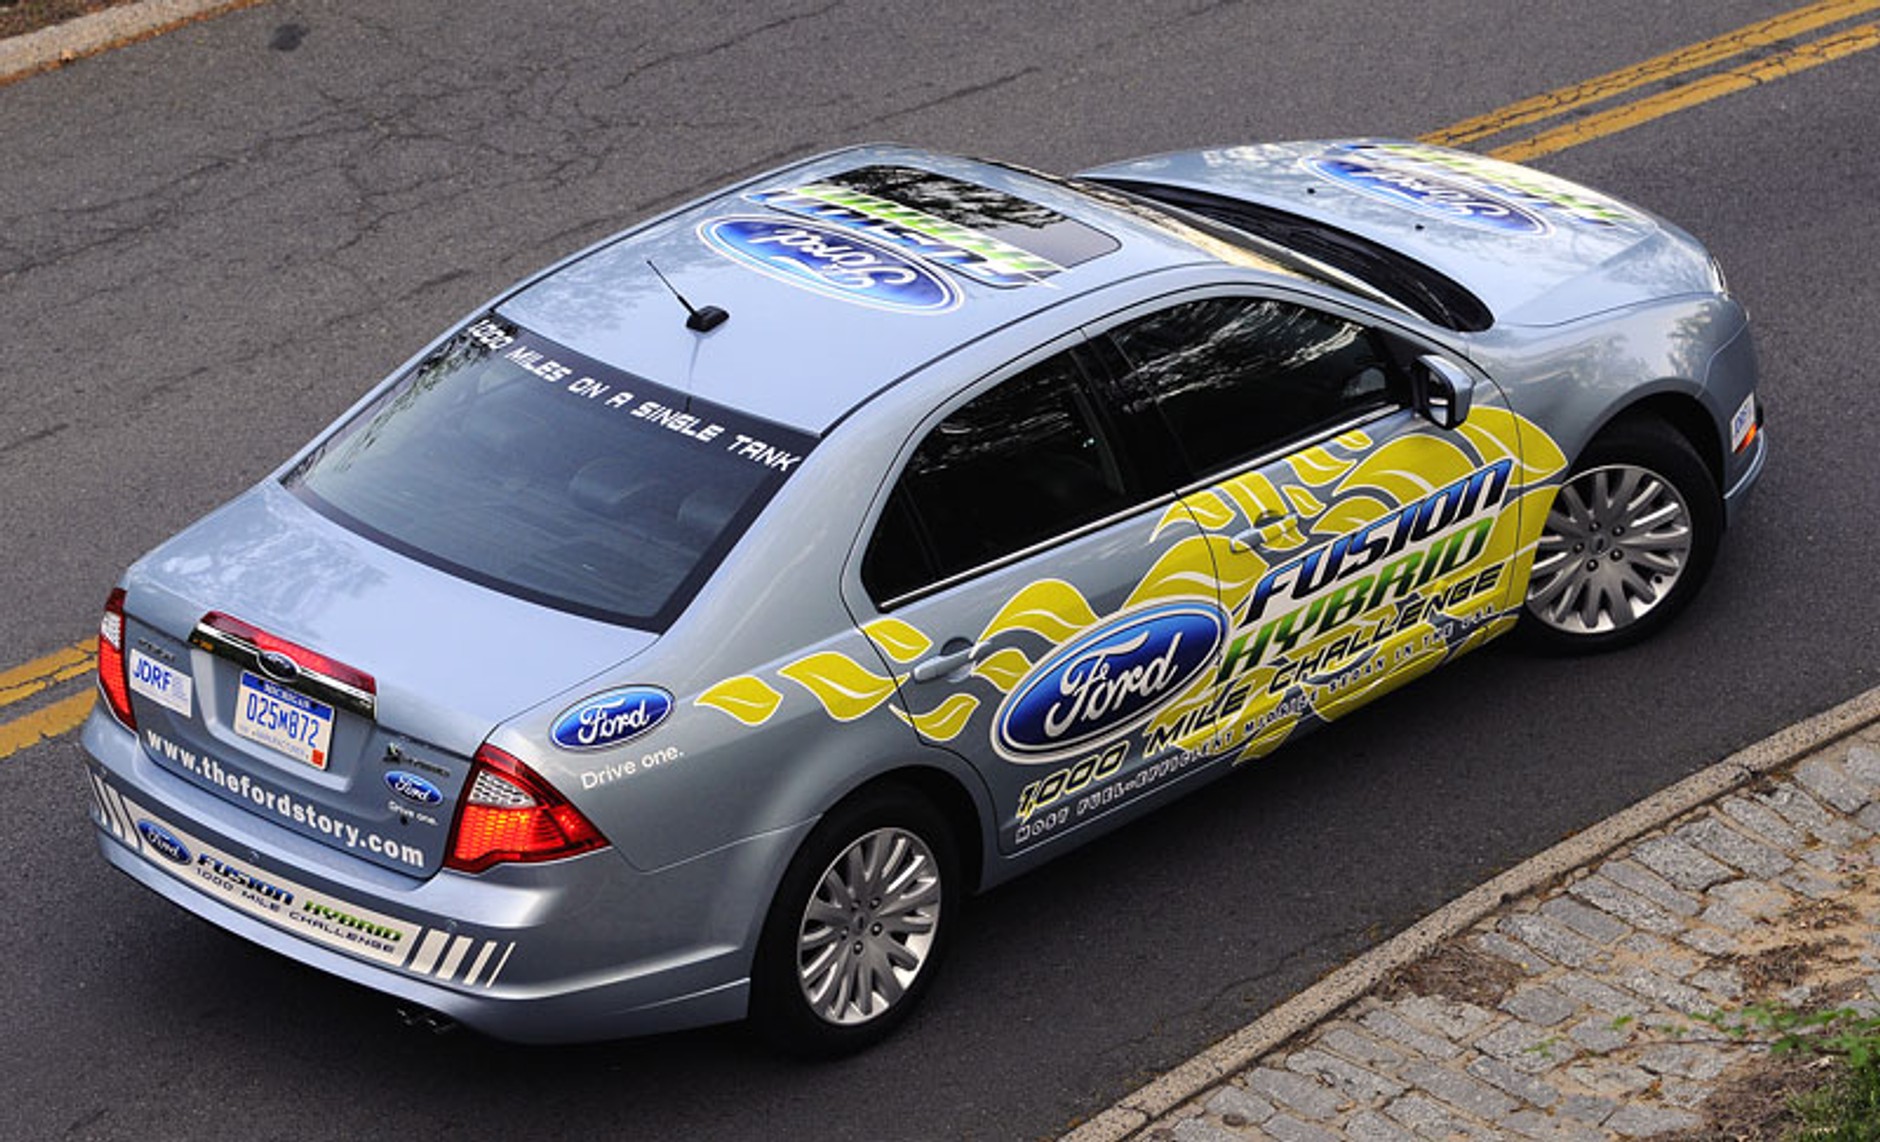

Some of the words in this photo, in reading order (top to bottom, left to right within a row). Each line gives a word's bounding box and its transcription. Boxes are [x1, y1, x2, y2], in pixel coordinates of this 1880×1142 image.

[504, 347, 572, 383] MILES
[568, 377, 610, 399] ON
[605, 392, 635, 409] A
[631, 400, 725, 443] SINGLE
[727, 434, 801, 472] TANK
[1212, 516, 1496, 685] HYBRID
[1240, 458, 1515, 627] FUSION
[134, 658, 172, 691] JDRF
[1143, 676, 1252, 759] MILE
[1268, 564, 1504, 694] CHALLENGE
[148, 730, 425, 868] www.thefordstory.com
[581, 761, 637, 790] Drive
[641, 746, 685, 768] one.
[198, 853, 294, 905] FUSION
[303, 901, 403, 941] HYBRID
[241, 891, 281, 913] MILE
[289, 911, 395, 953] CHALLENGE
